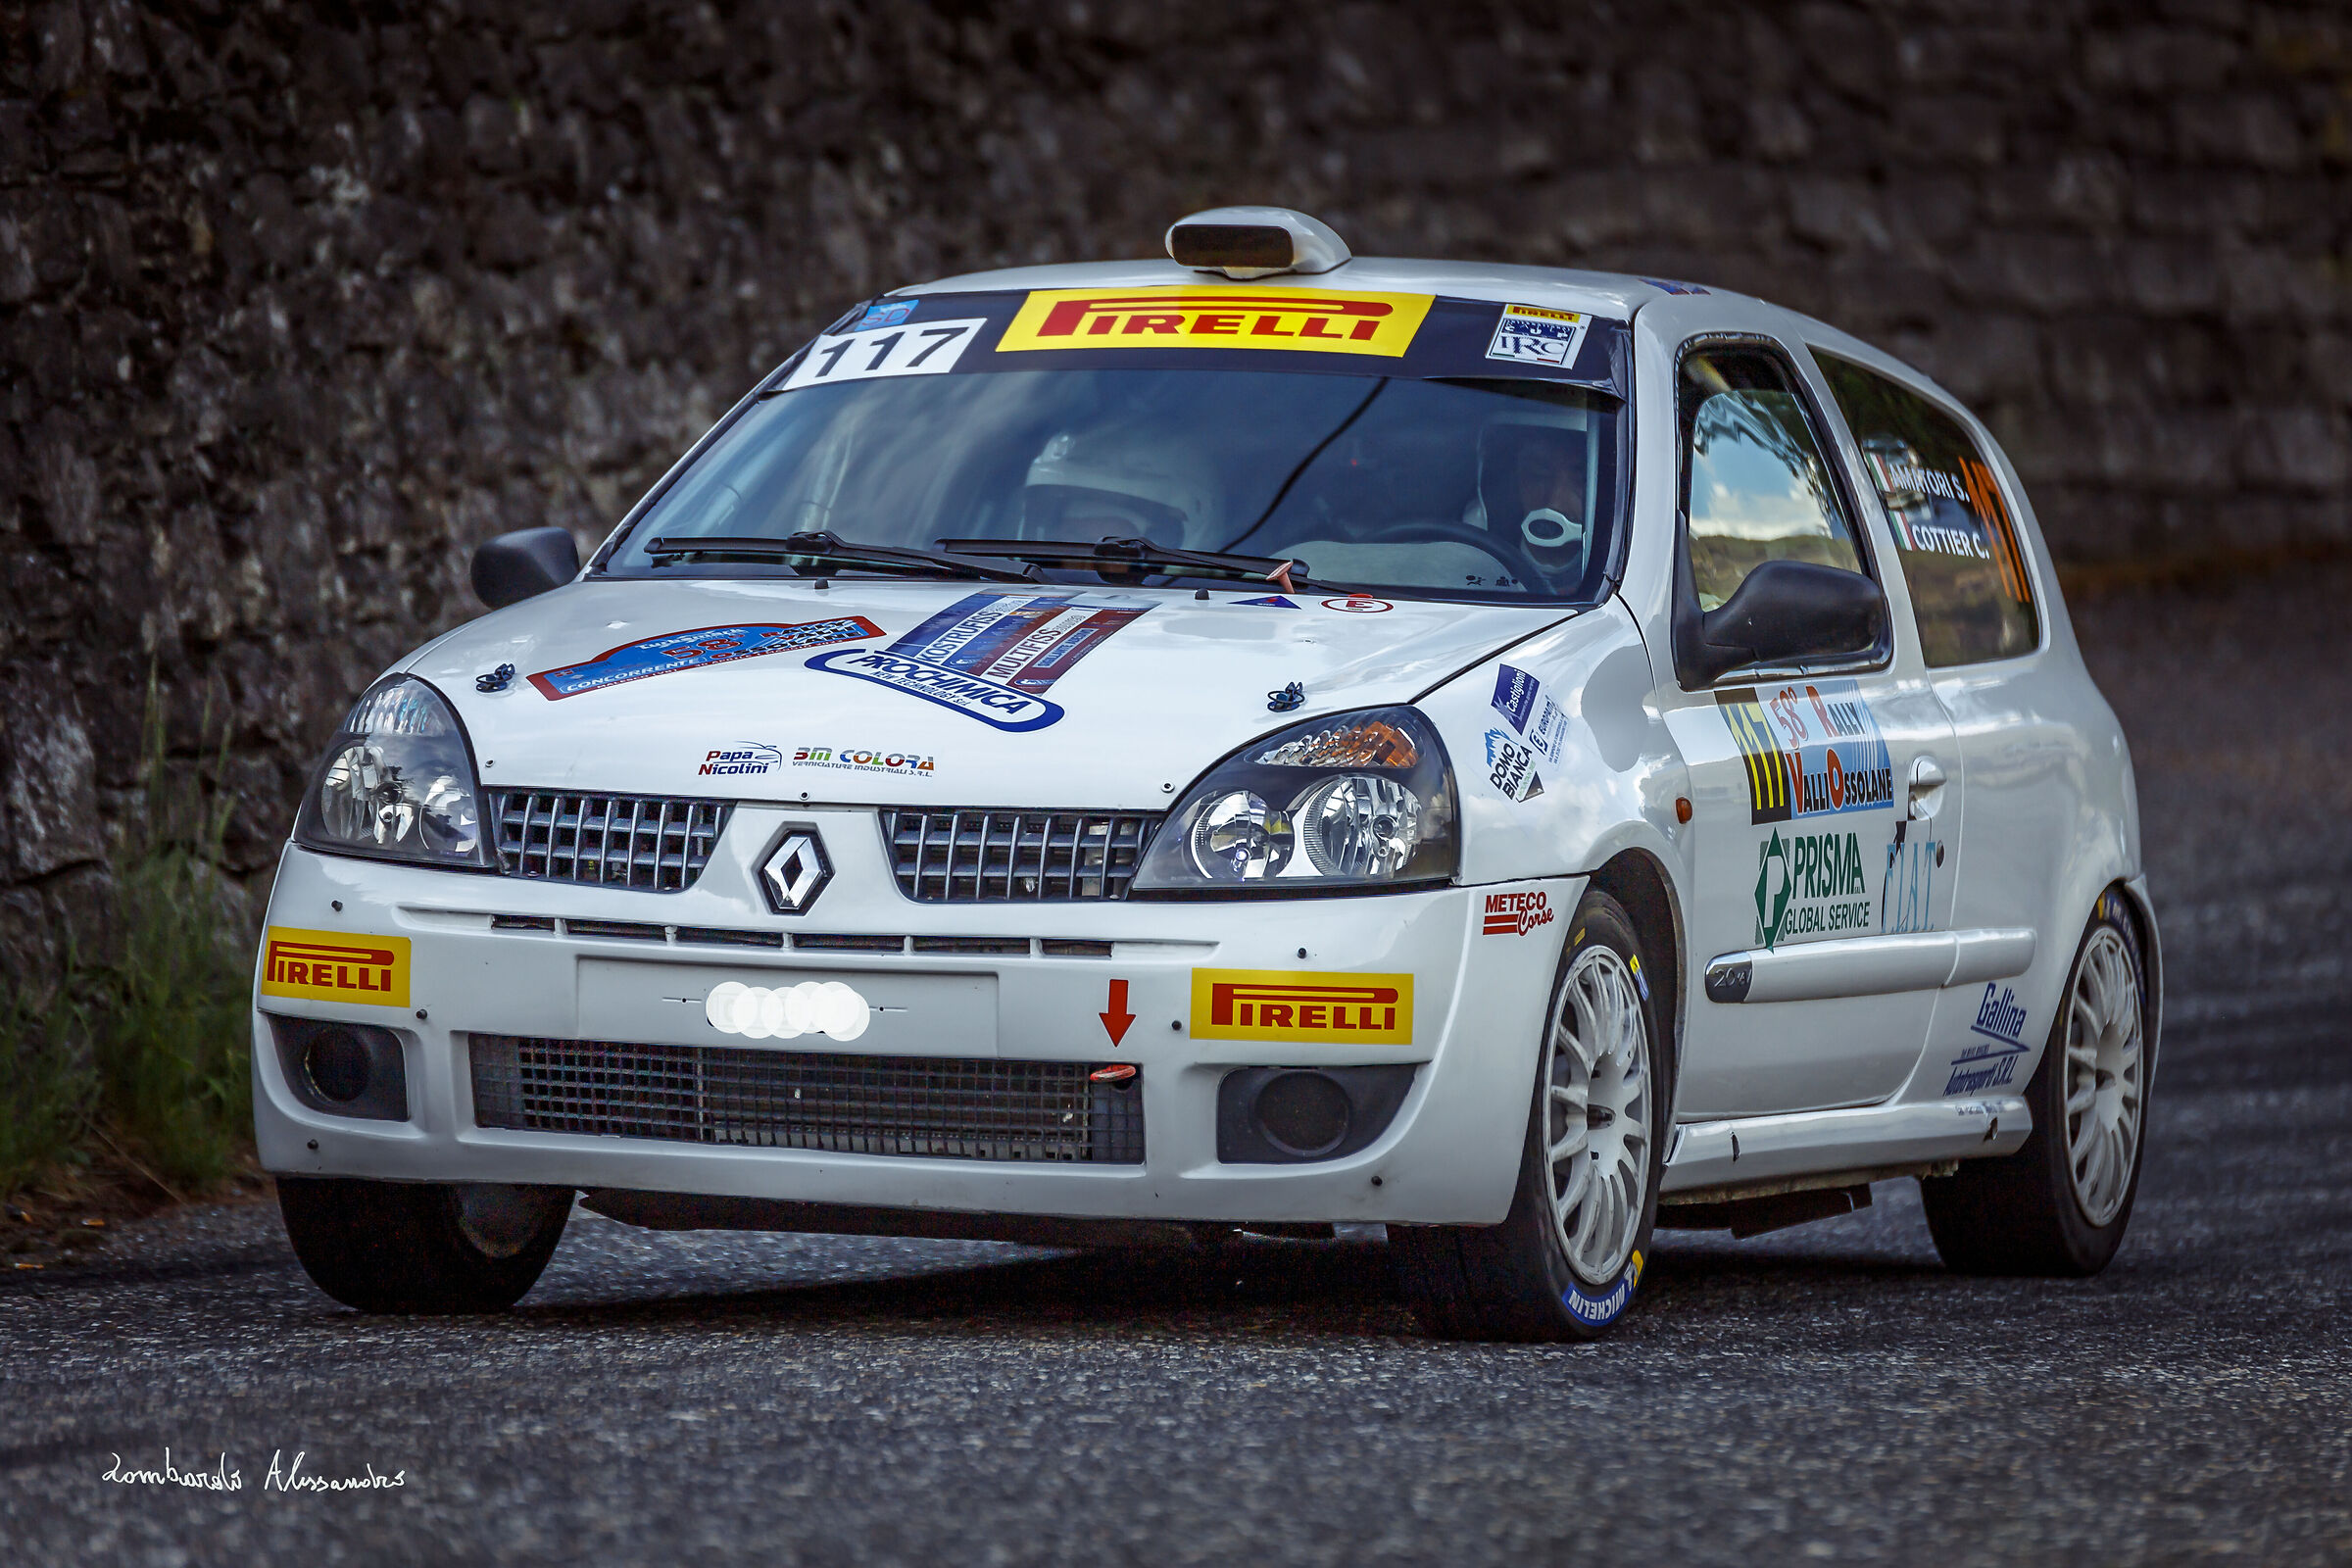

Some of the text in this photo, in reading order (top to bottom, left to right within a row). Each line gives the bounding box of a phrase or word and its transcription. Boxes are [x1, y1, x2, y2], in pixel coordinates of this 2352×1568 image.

[1037, 296, 1395, 341] PIRELLI
[814, 326, 970, 378] 117
[1500, 336, 1565, 356] IRC
[1888, 463, 1971, 503] AMATORI S.
[1912, 524, 1990, 561] COTTIER C.
[1346, 600, 1375, 609] E
[916, 611, 1003, 664] KOSTRUFISS
[987, 628, 1062, 679] MULTIFISS
[566, 658, 700, 692] CONCORRENTE
[846, 655, 1033, 714] PROCHIMICA
[896, 676, 957, 701] TECHNOLOGY
[1505, 668, 1527, 712] Castiglioni
[1805, 684, 1867, 738] RALLY
[698, 762, 768, 775] Nicolini
[706, 750, 754, 762] Papa
[1489, 743, 1516, 791] DOMO
[1501, 745, 1533, 801] BIANCA
[1725, 702, 1786, 810] 117
[1791, 831, 1866, 901] PRISMA
[1485, 891, 1547, 913] METECO
[1517, 906, 1554, 937] Corse
[1785, 901, 1871, 936] GLOBAL SERVICE
[267, 940, 395, 993] PIRELLI
[1211, 982, 1399, 1031] PIRELLI
[1976, 982, 2027, 1040] Gallina
[1568, 1283, 1626, 1321] MICHELIN
